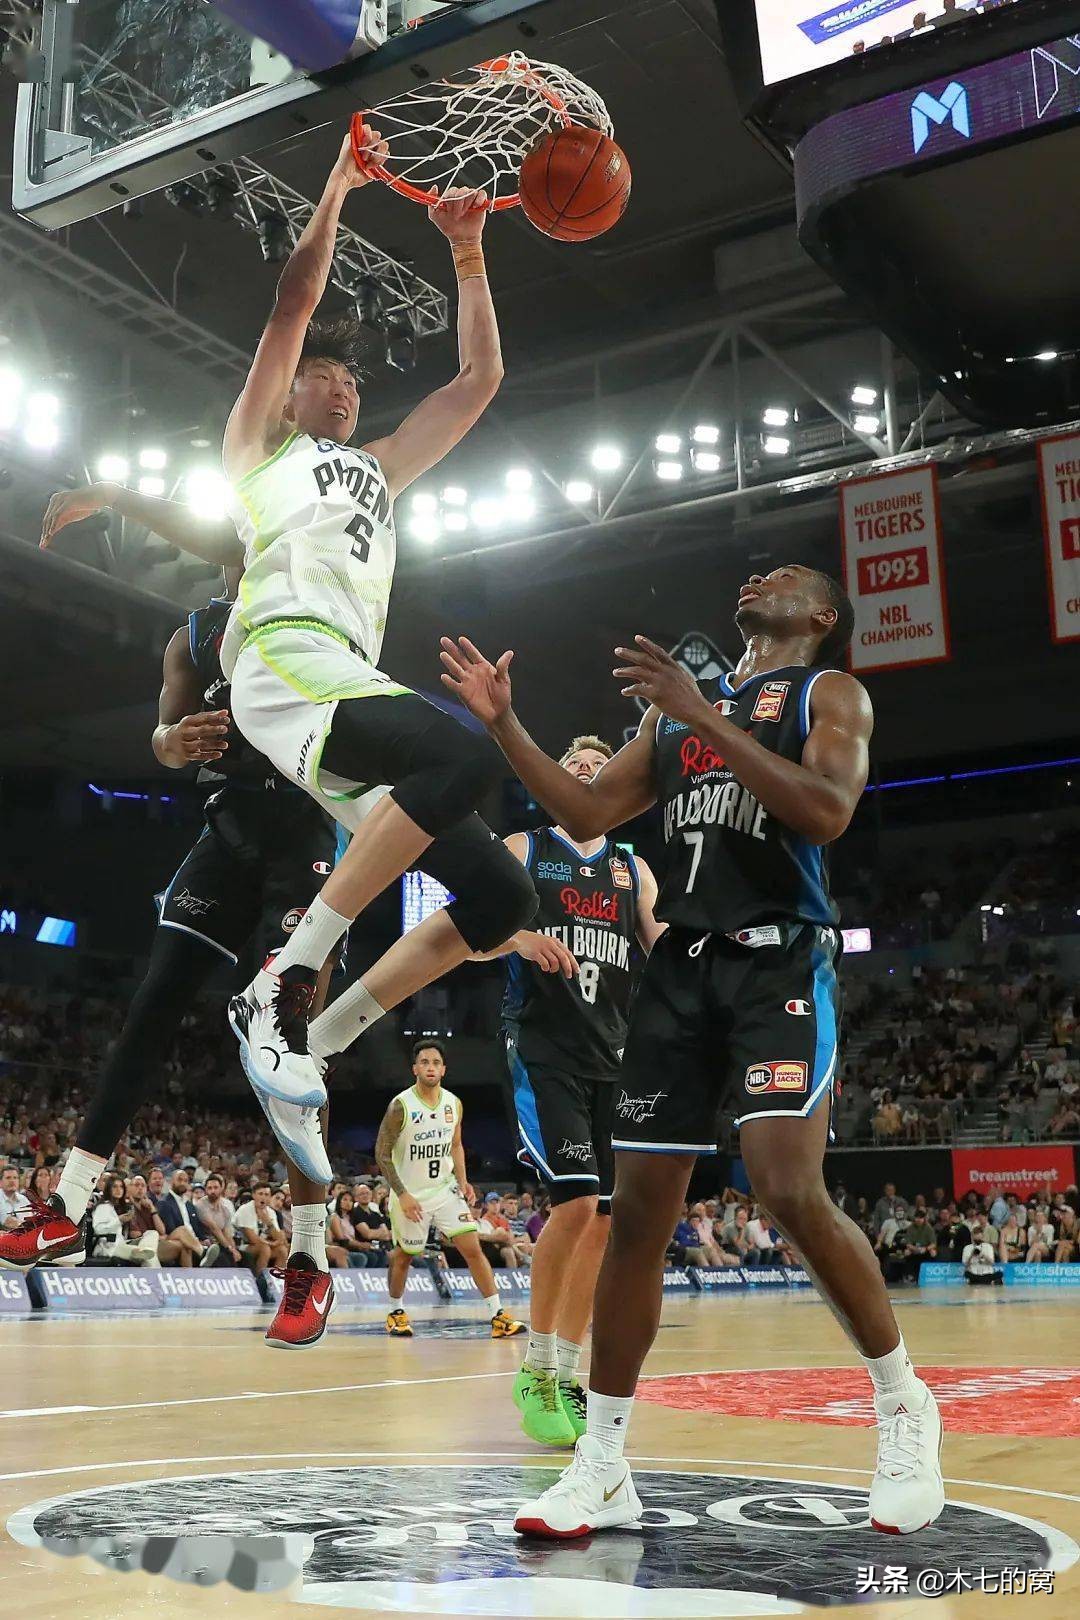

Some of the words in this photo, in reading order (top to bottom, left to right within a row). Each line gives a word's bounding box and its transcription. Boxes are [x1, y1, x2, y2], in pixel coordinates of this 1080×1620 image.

[854, 492, 923, 518] MELBOURNE
[855, 509, 925, 542] TIGERS
[866, 555, 919, 588] 1993
[879, 604, 911, 625] NBL
[861, 623, 933, 645] CHAMPIONS
[538, 861, 572, 874] soda
[682, 831, 704, 894] 7
[538, 872, 572, 882] stream
[580, 961, 600, 1005] 8
[749, 1071, 766, 1085] NBL
[414, 1129, 436, 1142] GOAT
[429, 1160, 440, 1179] 8
[969, 1168, 1059, 1183] Dreamstreet
[42, 1271, 151, 1296] Harcourts
[157, 1273, 254, 1296] Harcourts
